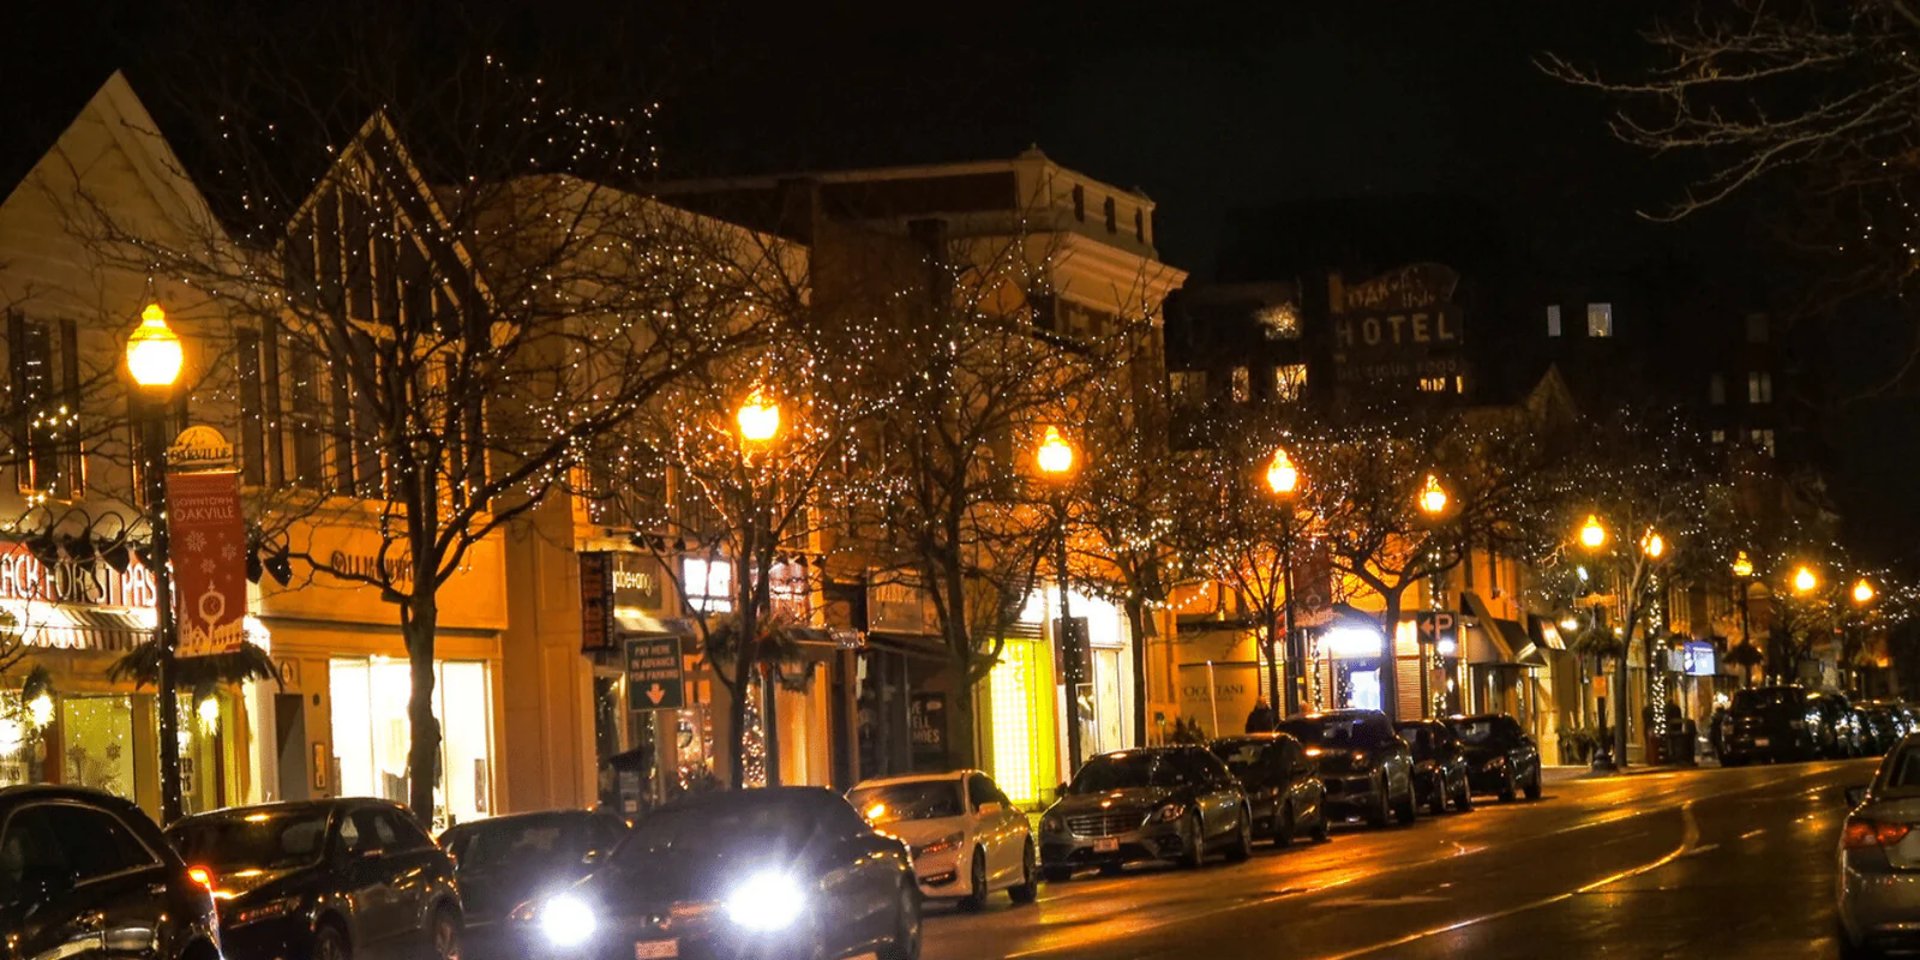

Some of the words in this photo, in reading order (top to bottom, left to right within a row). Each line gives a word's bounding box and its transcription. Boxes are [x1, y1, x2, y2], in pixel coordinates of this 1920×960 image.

[1334, 312, 1455, 349] HOTEL
[172, 497, 235, 510] DOWNTOWN
[174, 505, 236, 522] OAKVILLE
[0, 552, 41, 600] ACK
[1435, 614, 1453, 641] P
[634, 646, 649, 657] PAY
[631, 659, 641, 670] IN
[629, 671, 646, 682] FOR
